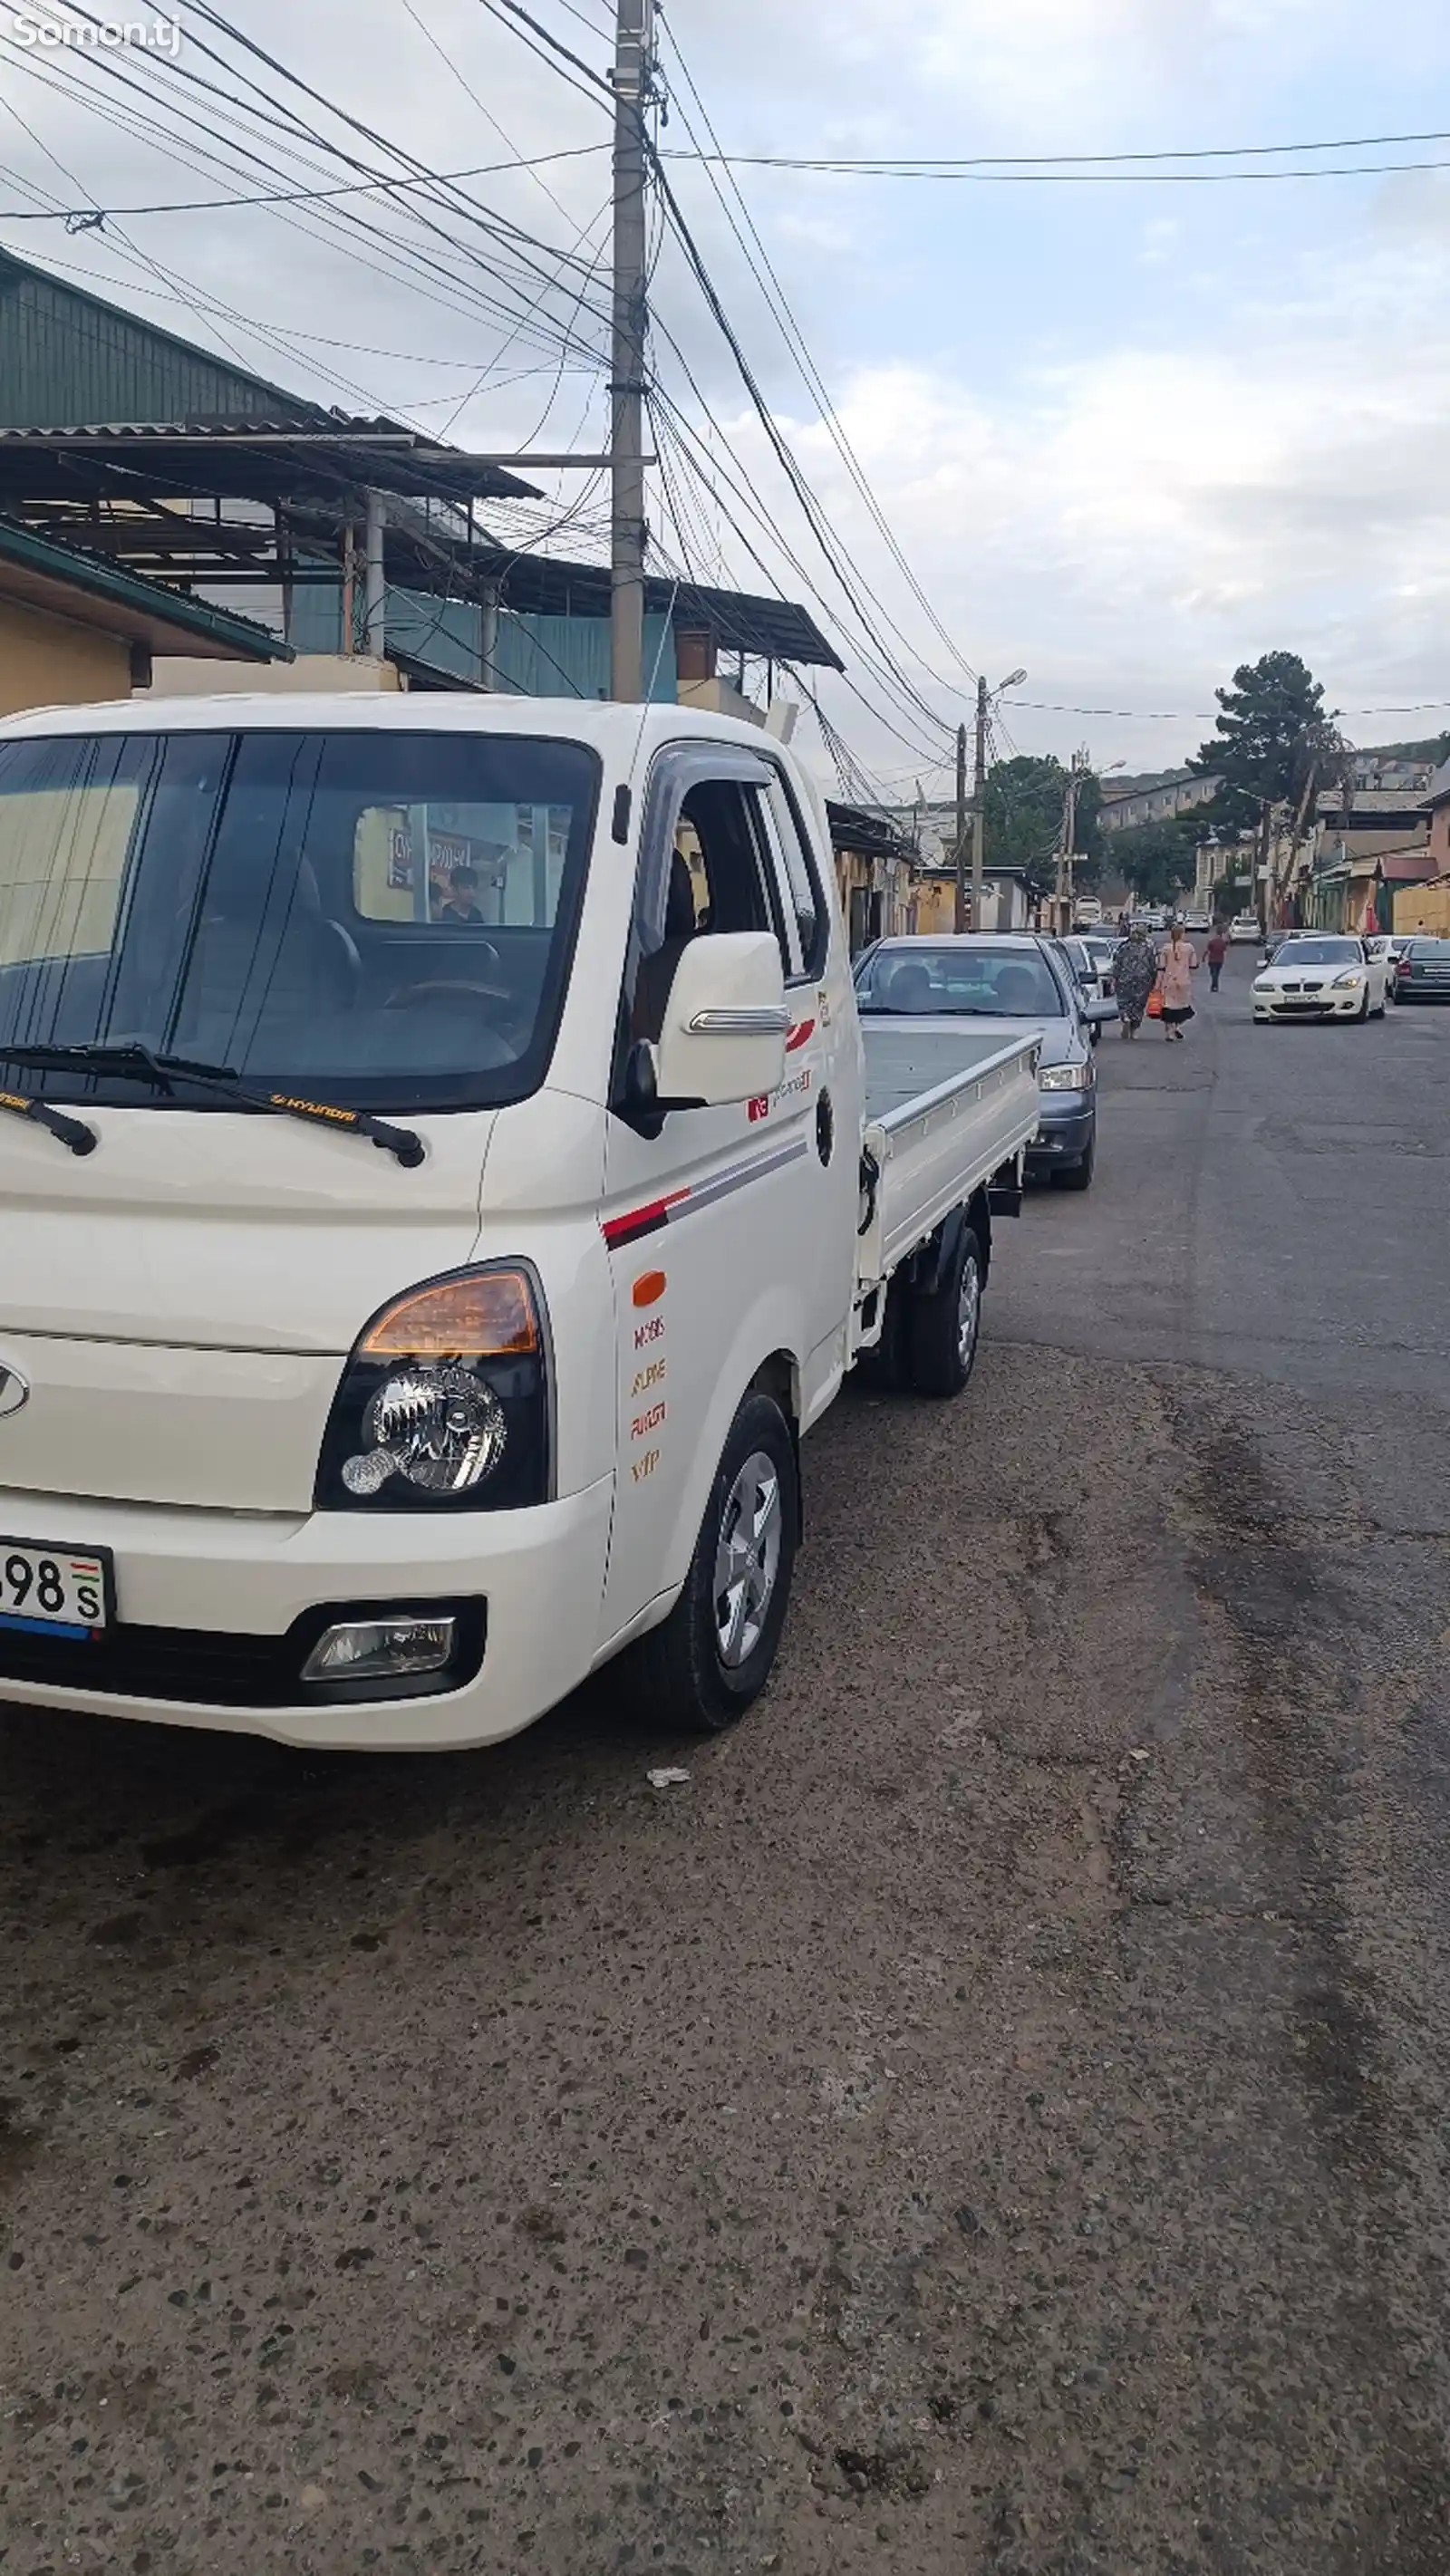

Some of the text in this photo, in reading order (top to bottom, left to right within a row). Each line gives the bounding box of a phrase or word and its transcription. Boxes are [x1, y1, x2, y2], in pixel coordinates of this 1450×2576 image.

[286, 1097, 357, 1121] HYUNDAI
[631, 1449, 660, 1482] VIP
[0, 1554, 100, 1619] 98 S
